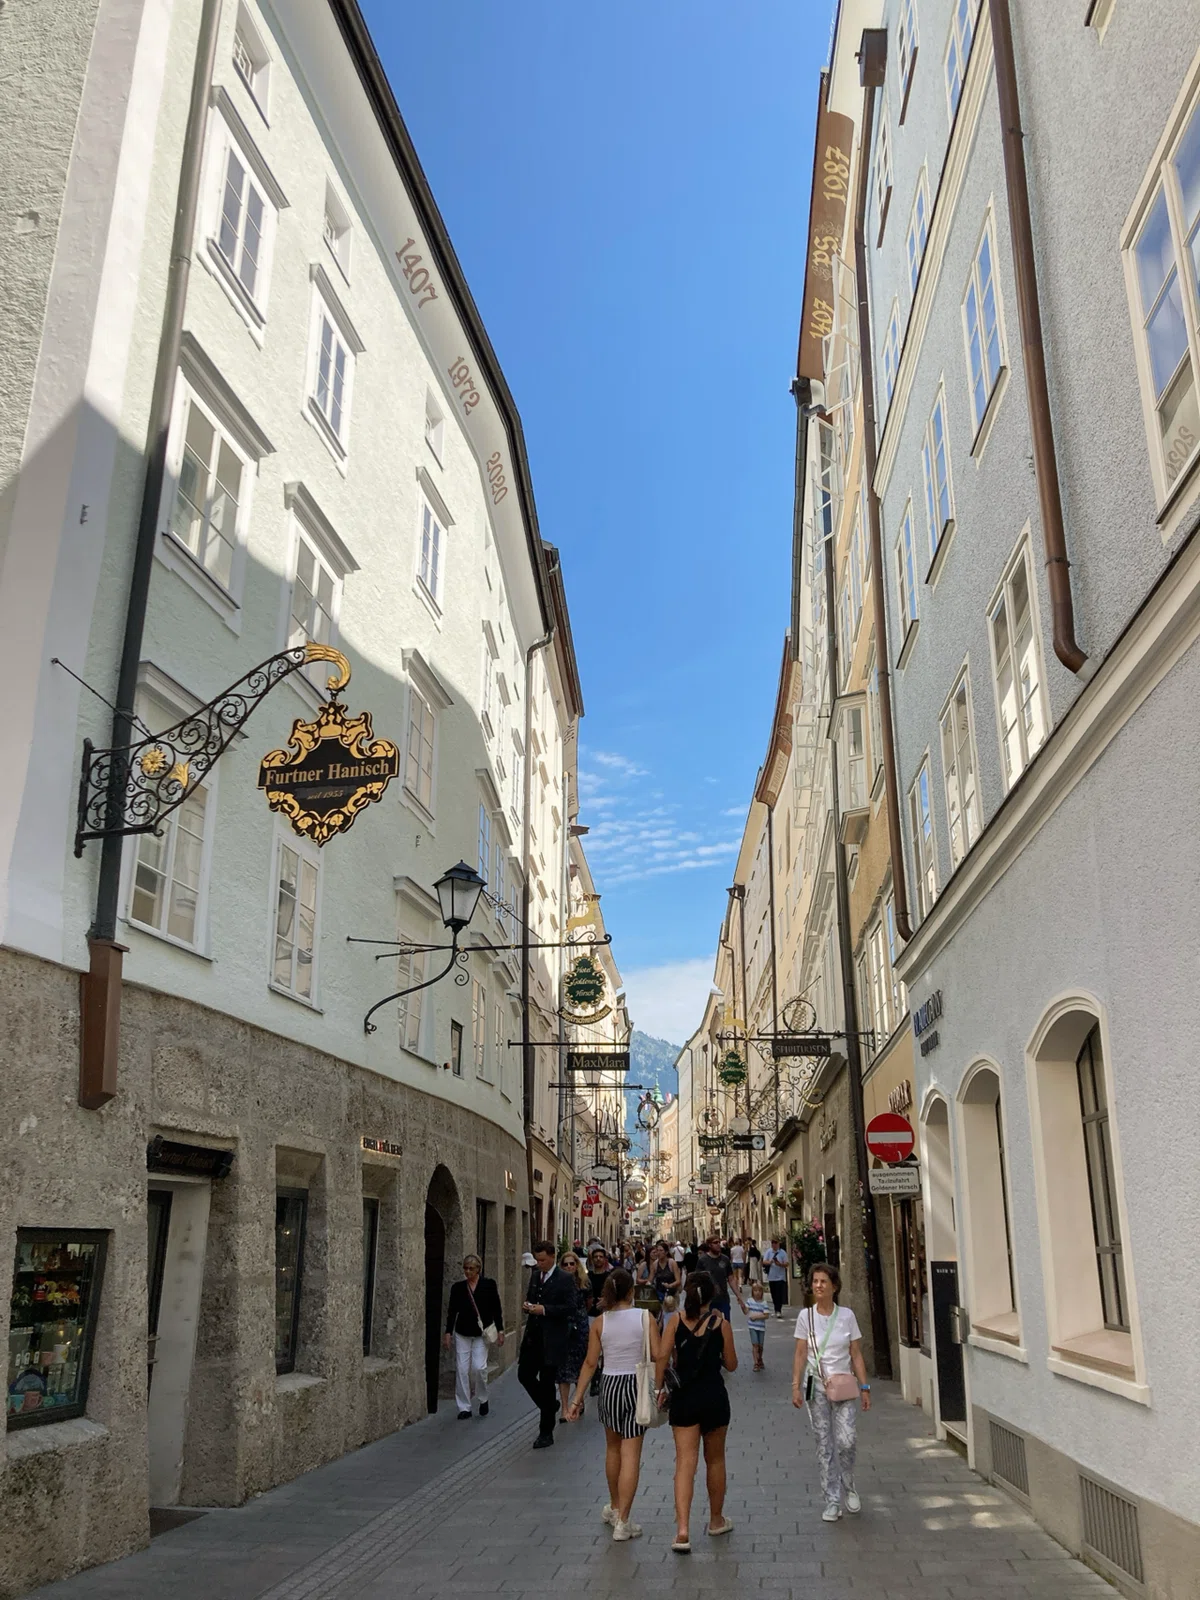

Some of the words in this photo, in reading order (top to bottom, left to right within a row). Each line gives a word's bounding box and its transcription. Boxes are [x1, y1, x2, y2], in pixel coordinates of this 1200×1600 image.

[823, 145, 851, 206] 1987
[395, 237, 439, 309] 1407
[809, 297, 836, 340] 1407
[447, 355, 481, 416] 1972
[485, 451, 508, 506] 2020
[265, 768, 323, 786] Furtner
[327, 759, 390, 780] Hanisch
[322, 789, 344, 799] 1955
[576, 966, 592, 974] Hotel
[572, 977, 597, 986] Goldener
[575, 988, 595, 997] Hirsch
[775, 1045, 828, 1054] SPIRITUOSEN
[572, 1055, 626, 1068] MaxMara
